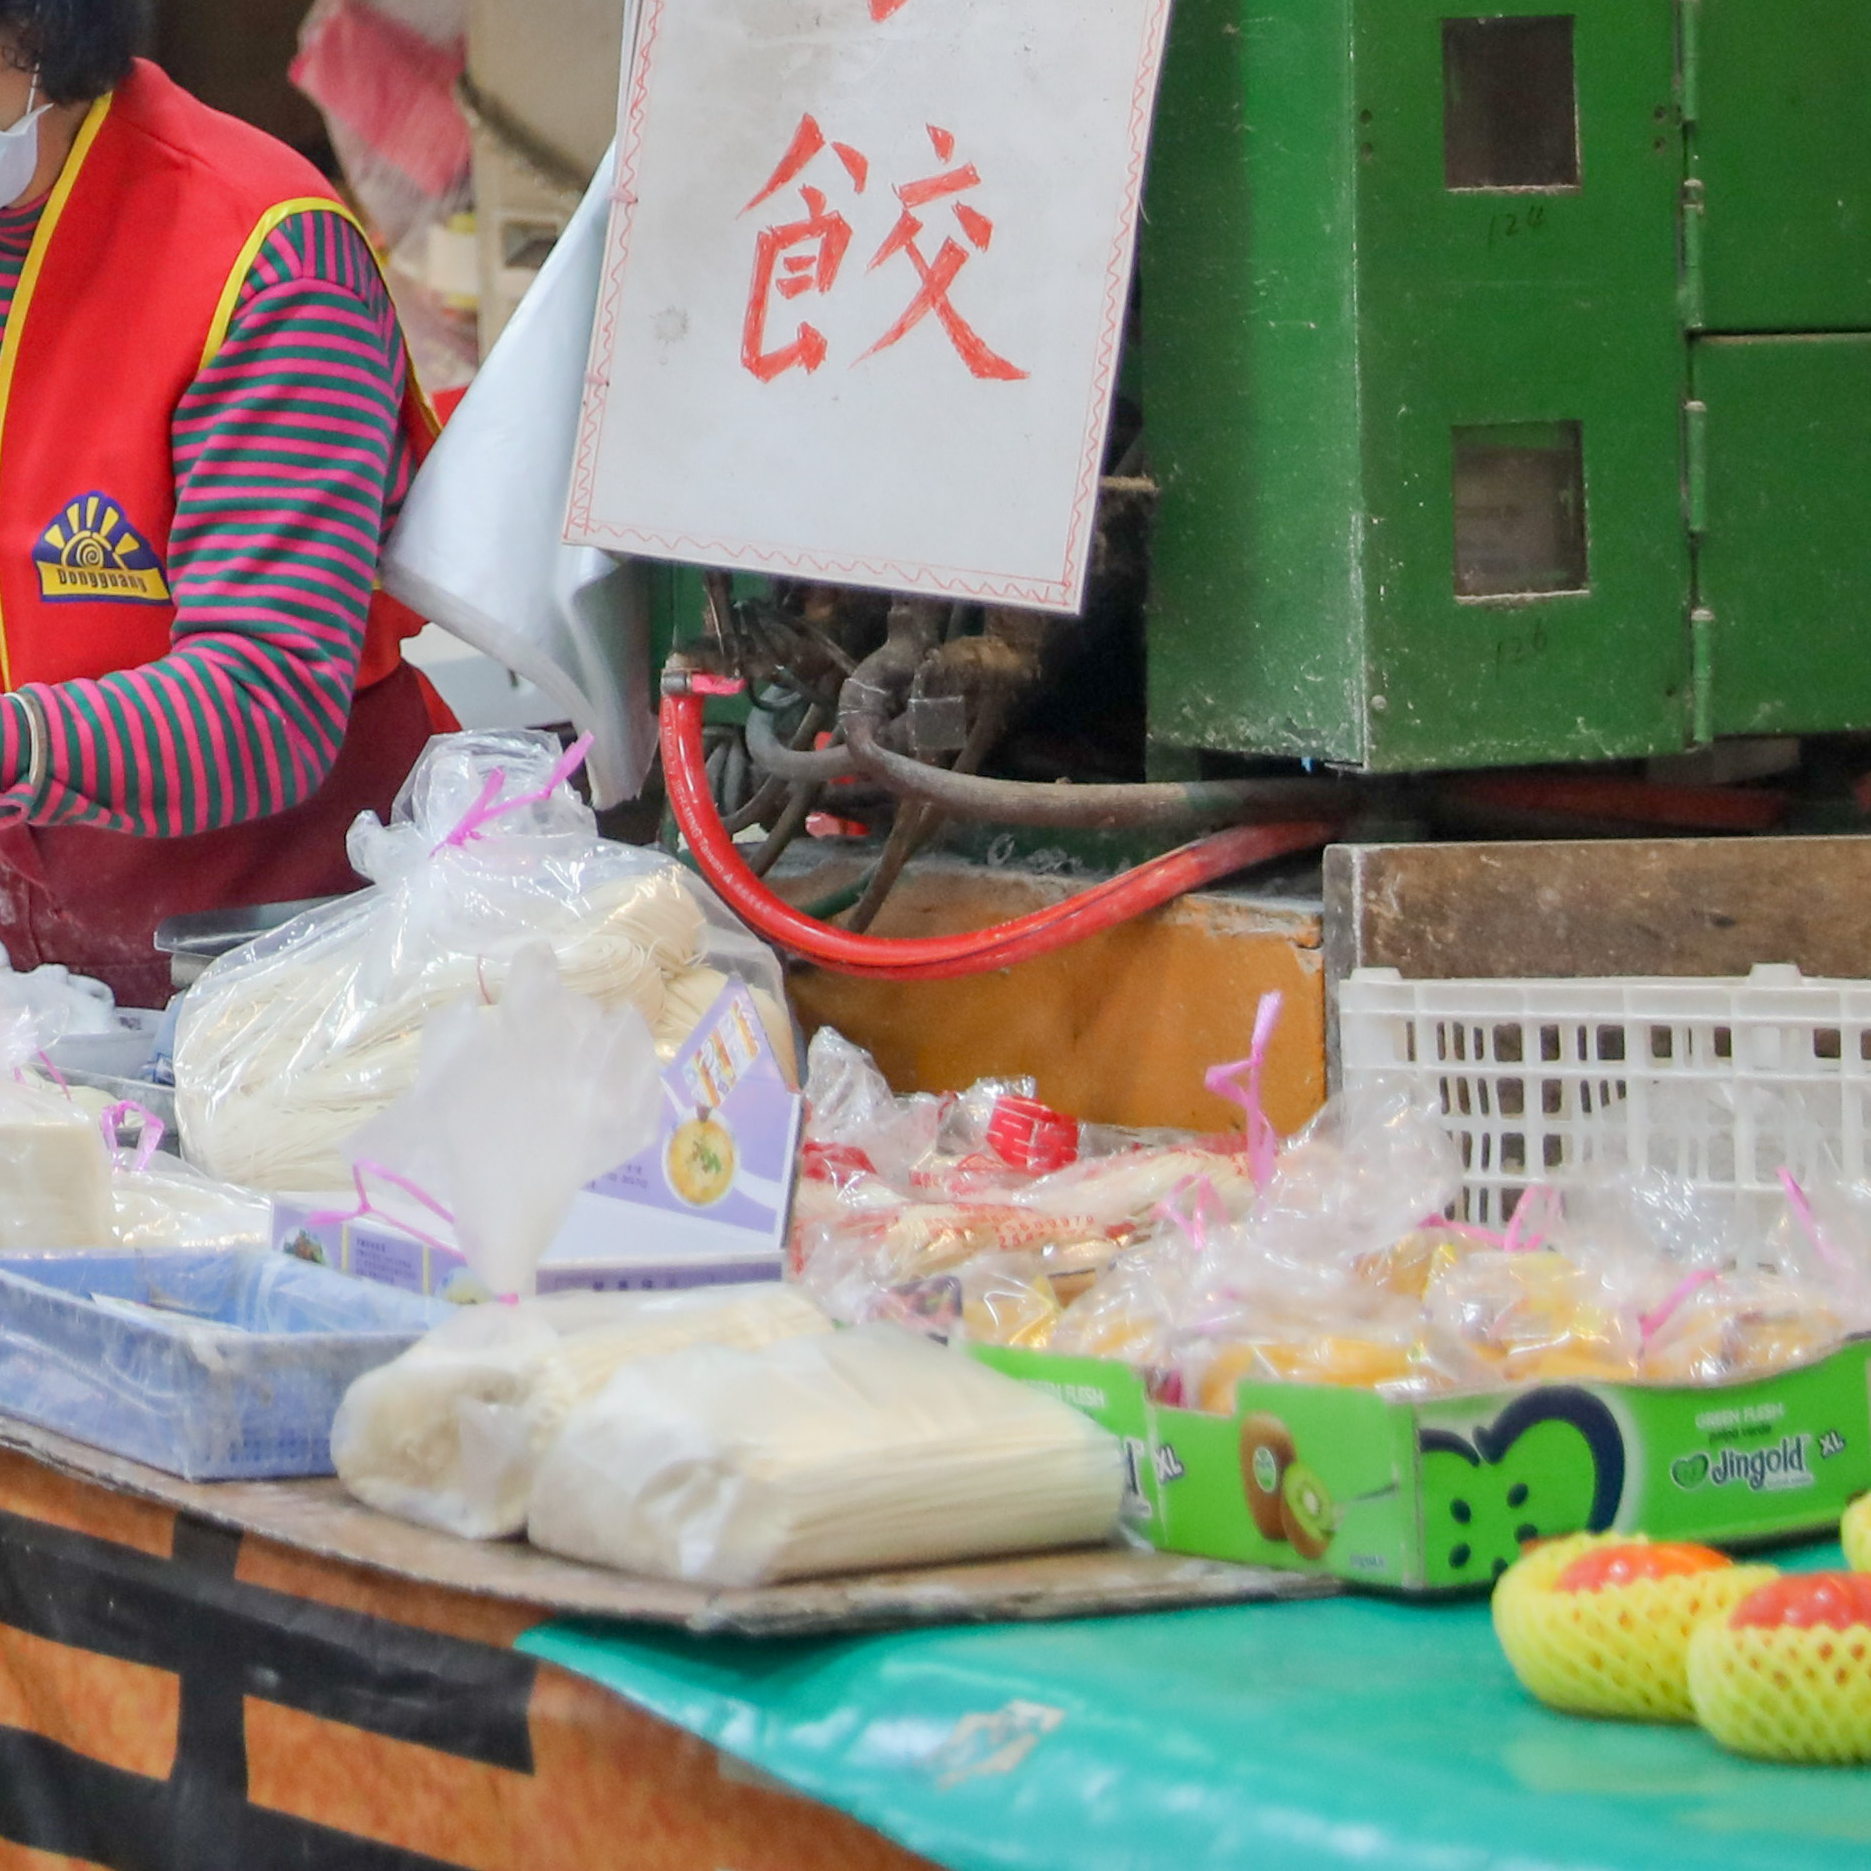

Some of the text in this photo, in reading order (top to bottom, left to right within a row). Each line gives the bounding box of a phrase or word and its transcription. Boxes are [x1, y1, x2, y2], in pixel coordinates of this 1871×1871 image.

[57, 569, 149, 593] Dongguang
[1156, 1442, 1185, 1483] XL
[1818, 1429, 1846, 1460] XL
[1711, 1437, 1804, 1490] Jingold
